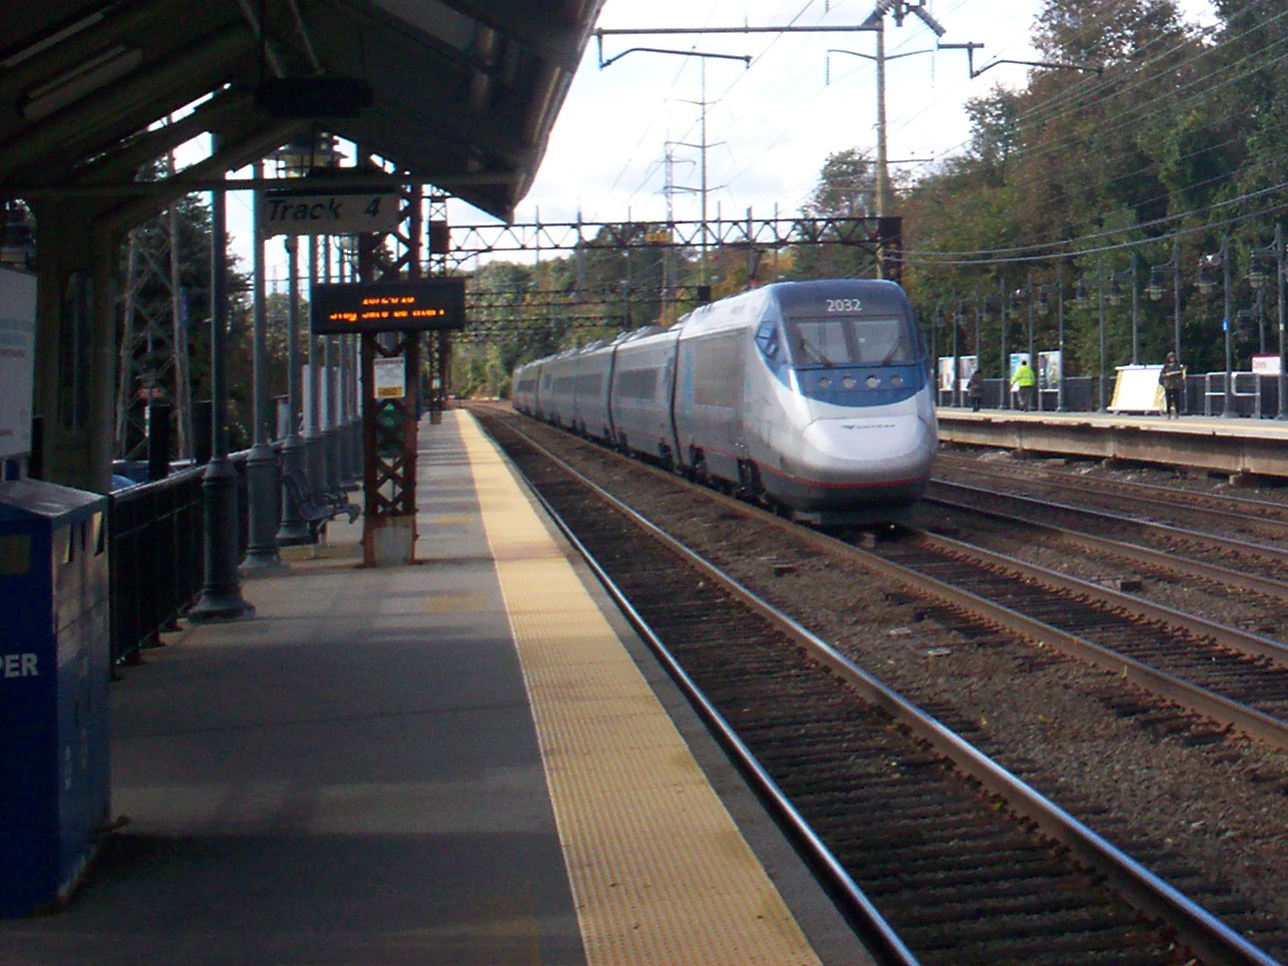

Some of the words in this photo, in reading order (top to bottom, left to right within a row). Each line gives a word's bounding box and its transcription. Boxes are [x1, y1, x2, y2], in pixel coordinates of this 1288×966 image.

[268, 199, 343, 223] Track
[364, 197, 380, 218] 4
[826, 299, 862, 312] 2032
[0, 652, 39, 678] ER
